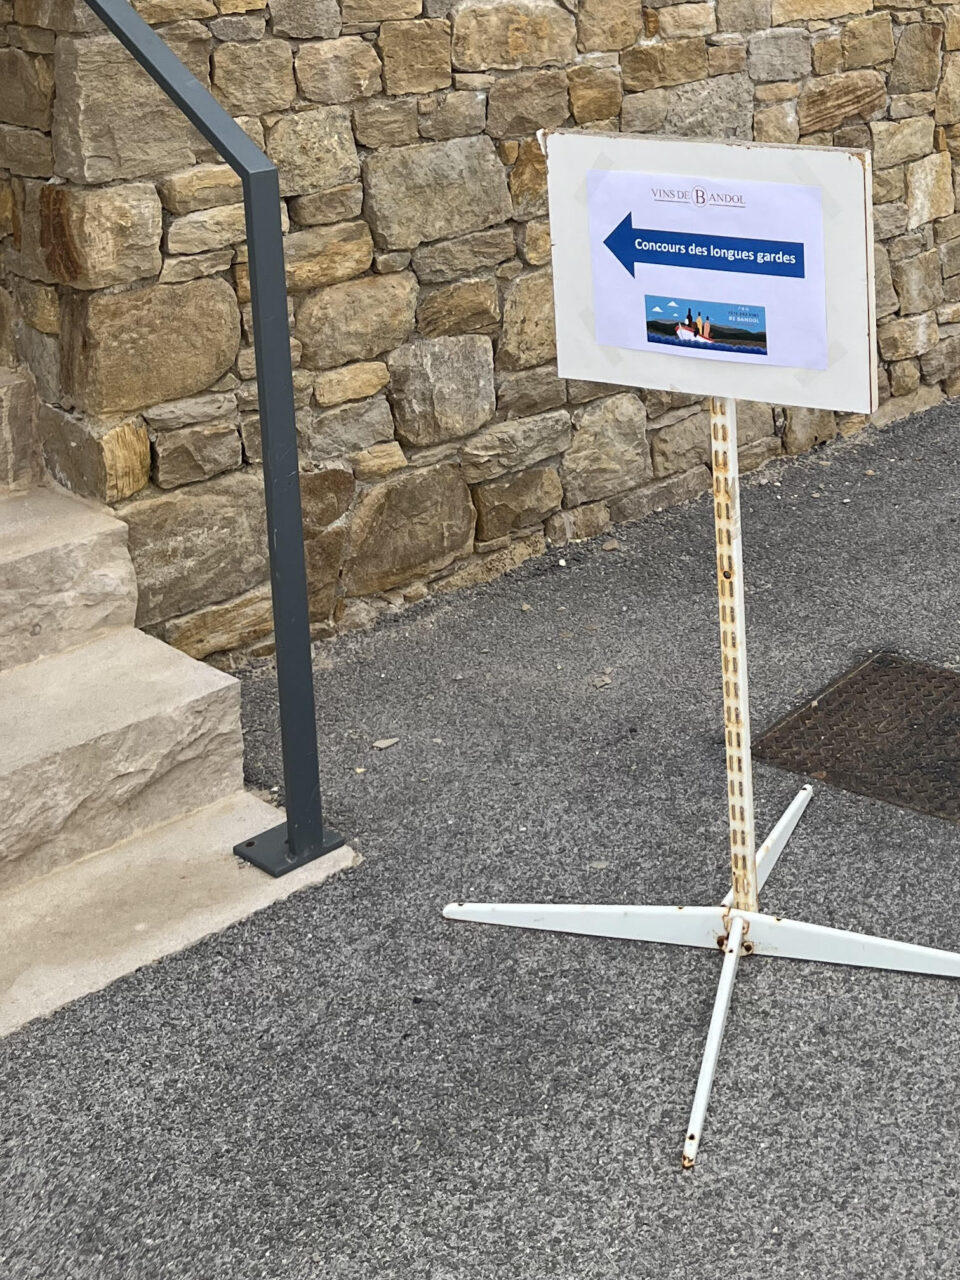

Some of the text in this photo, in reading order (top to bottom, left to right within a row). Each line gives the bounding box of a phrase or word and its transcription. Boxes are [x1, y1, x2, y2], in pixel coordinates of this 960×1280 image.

[651, 188, 746, 204] VINS DE BANDOL
[634, 238, 796, 264] Concours des longues gardes
